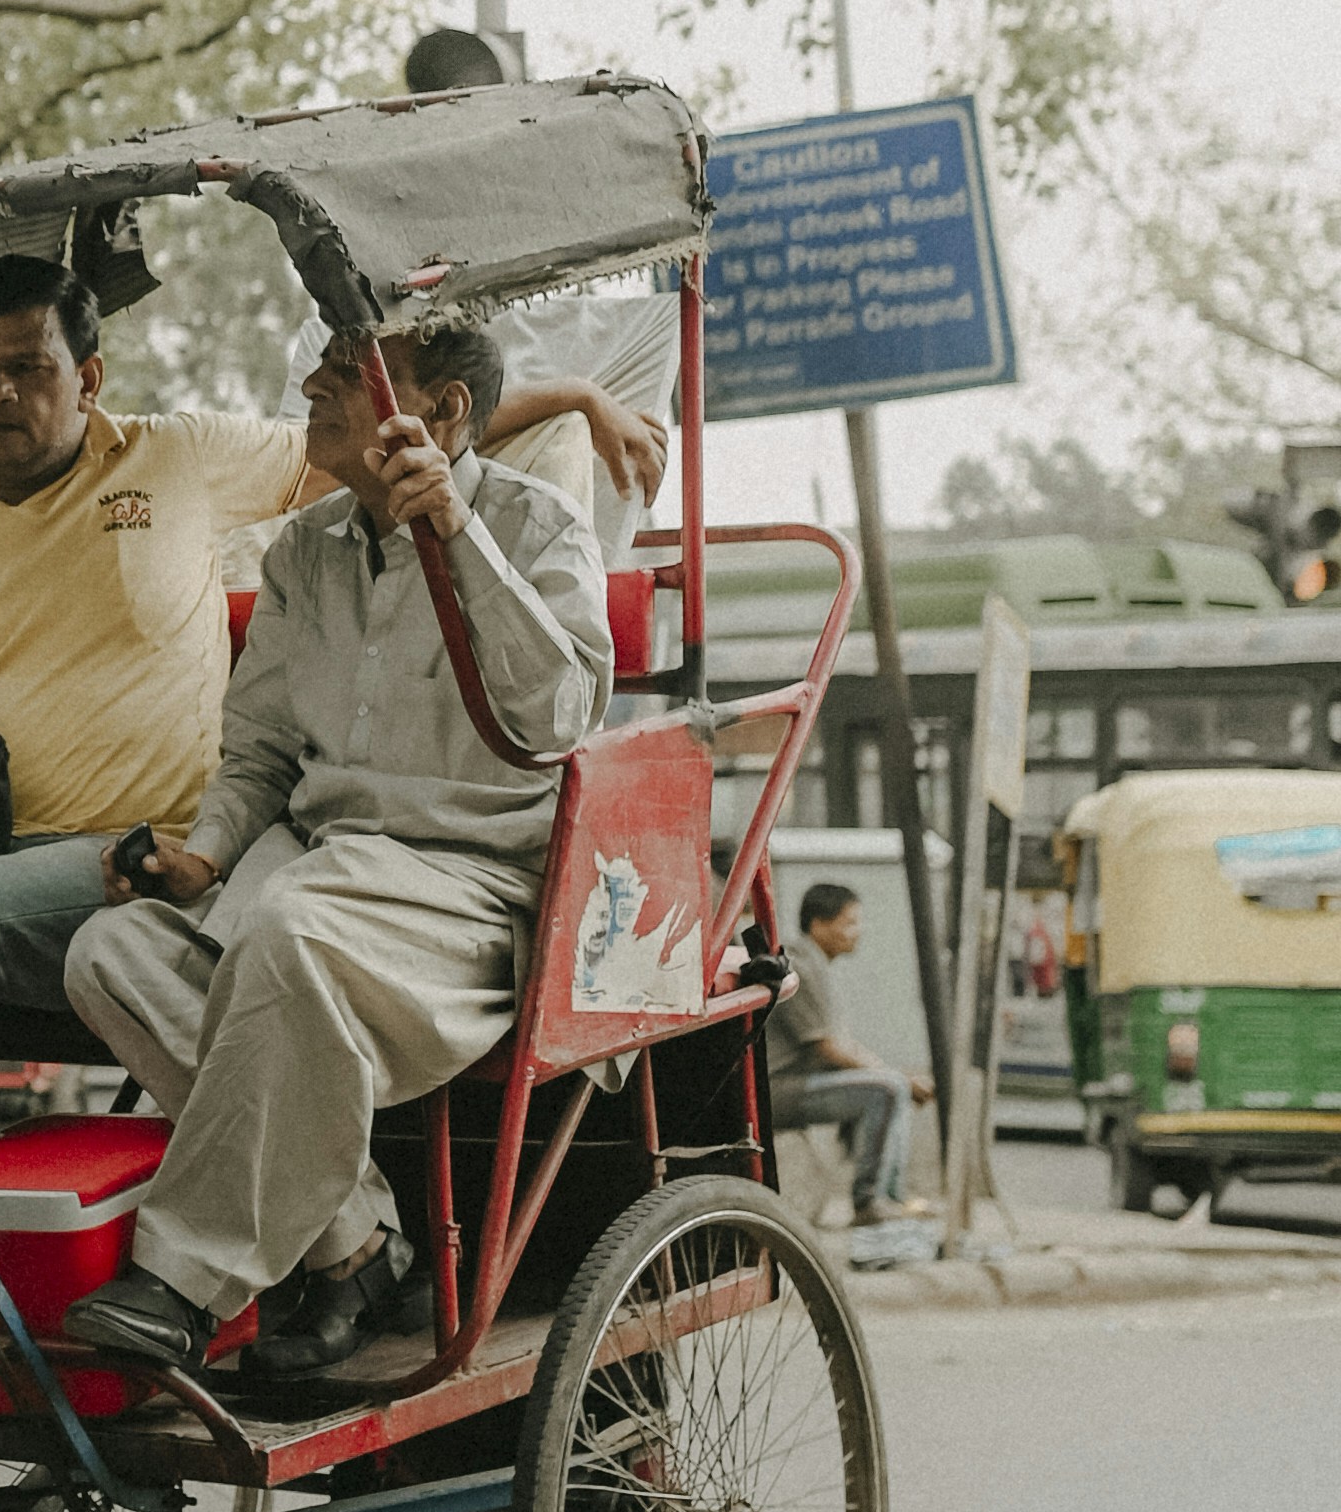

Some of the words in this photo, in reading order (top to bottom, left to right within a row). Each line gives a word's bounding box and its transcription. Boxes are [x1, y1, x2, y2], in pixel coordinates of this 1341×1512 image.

[732, 138, 880, 182] Caution
[909, 154, 941, 190] of
[889, 187, 967, 225] Road
[786, 233, 919, 273] Progress
[741, 277, 853, 316] Parking
[857, 263, 957, 299] Please
[862, 290, 976, 333] Ground
